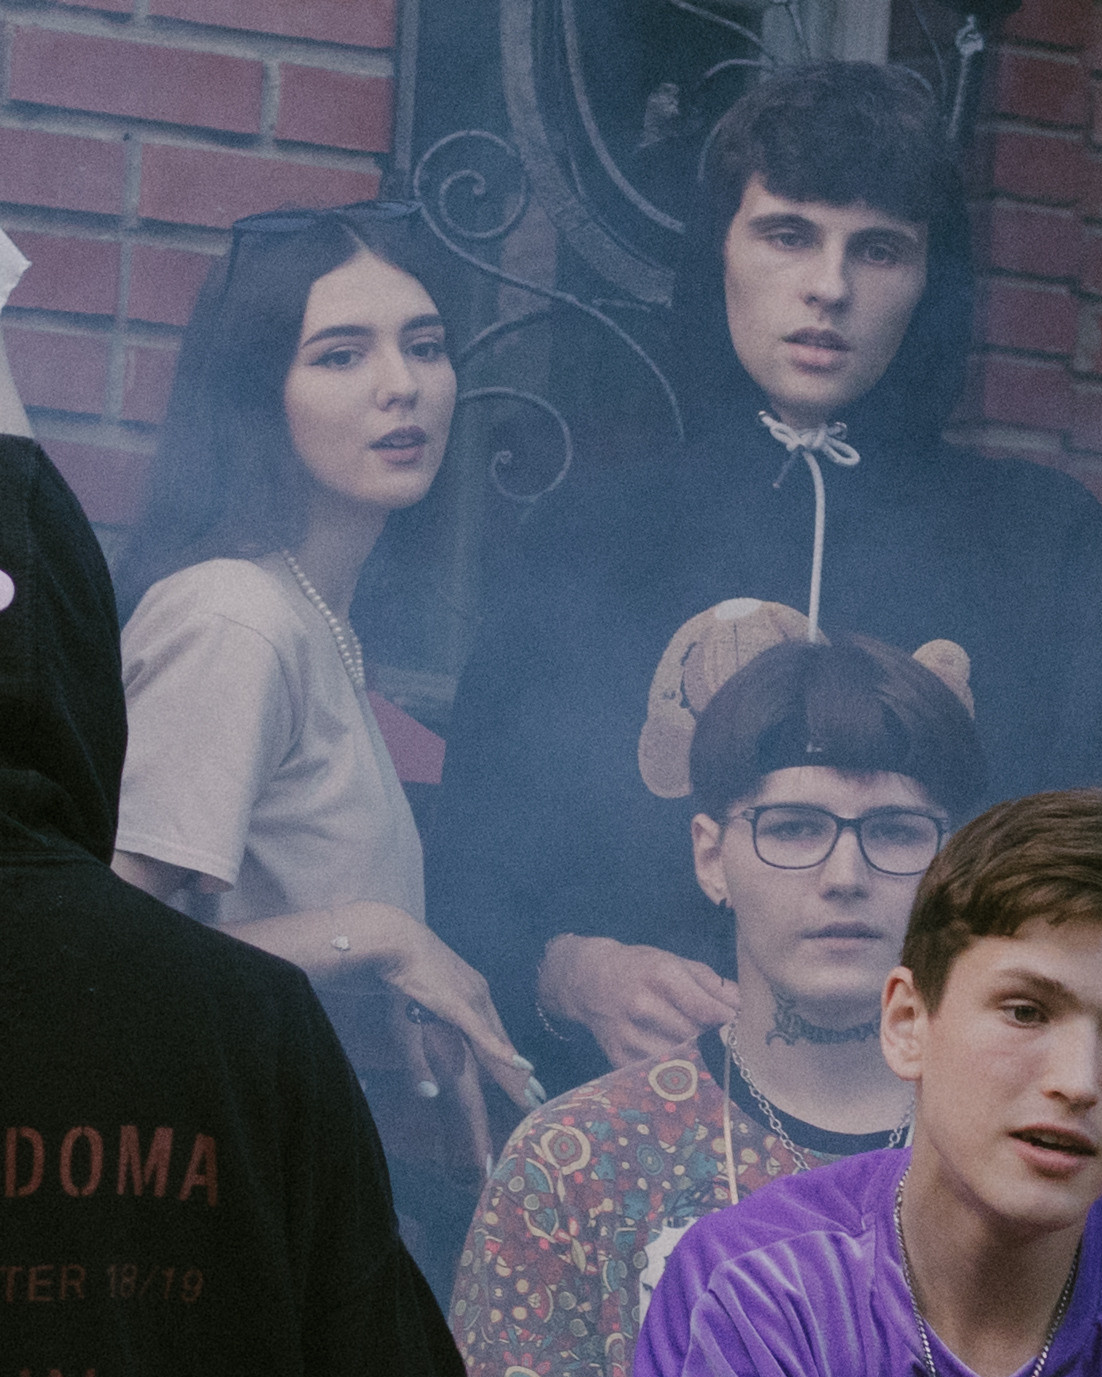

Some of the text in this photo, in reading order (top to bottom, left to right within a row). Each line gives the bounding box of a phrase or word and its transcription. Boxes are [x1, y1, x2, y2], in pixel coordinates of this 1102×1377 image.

[4, 1125, 219, 1207] DOMA
[0, 1262, 204, 1303] TER 18/19
